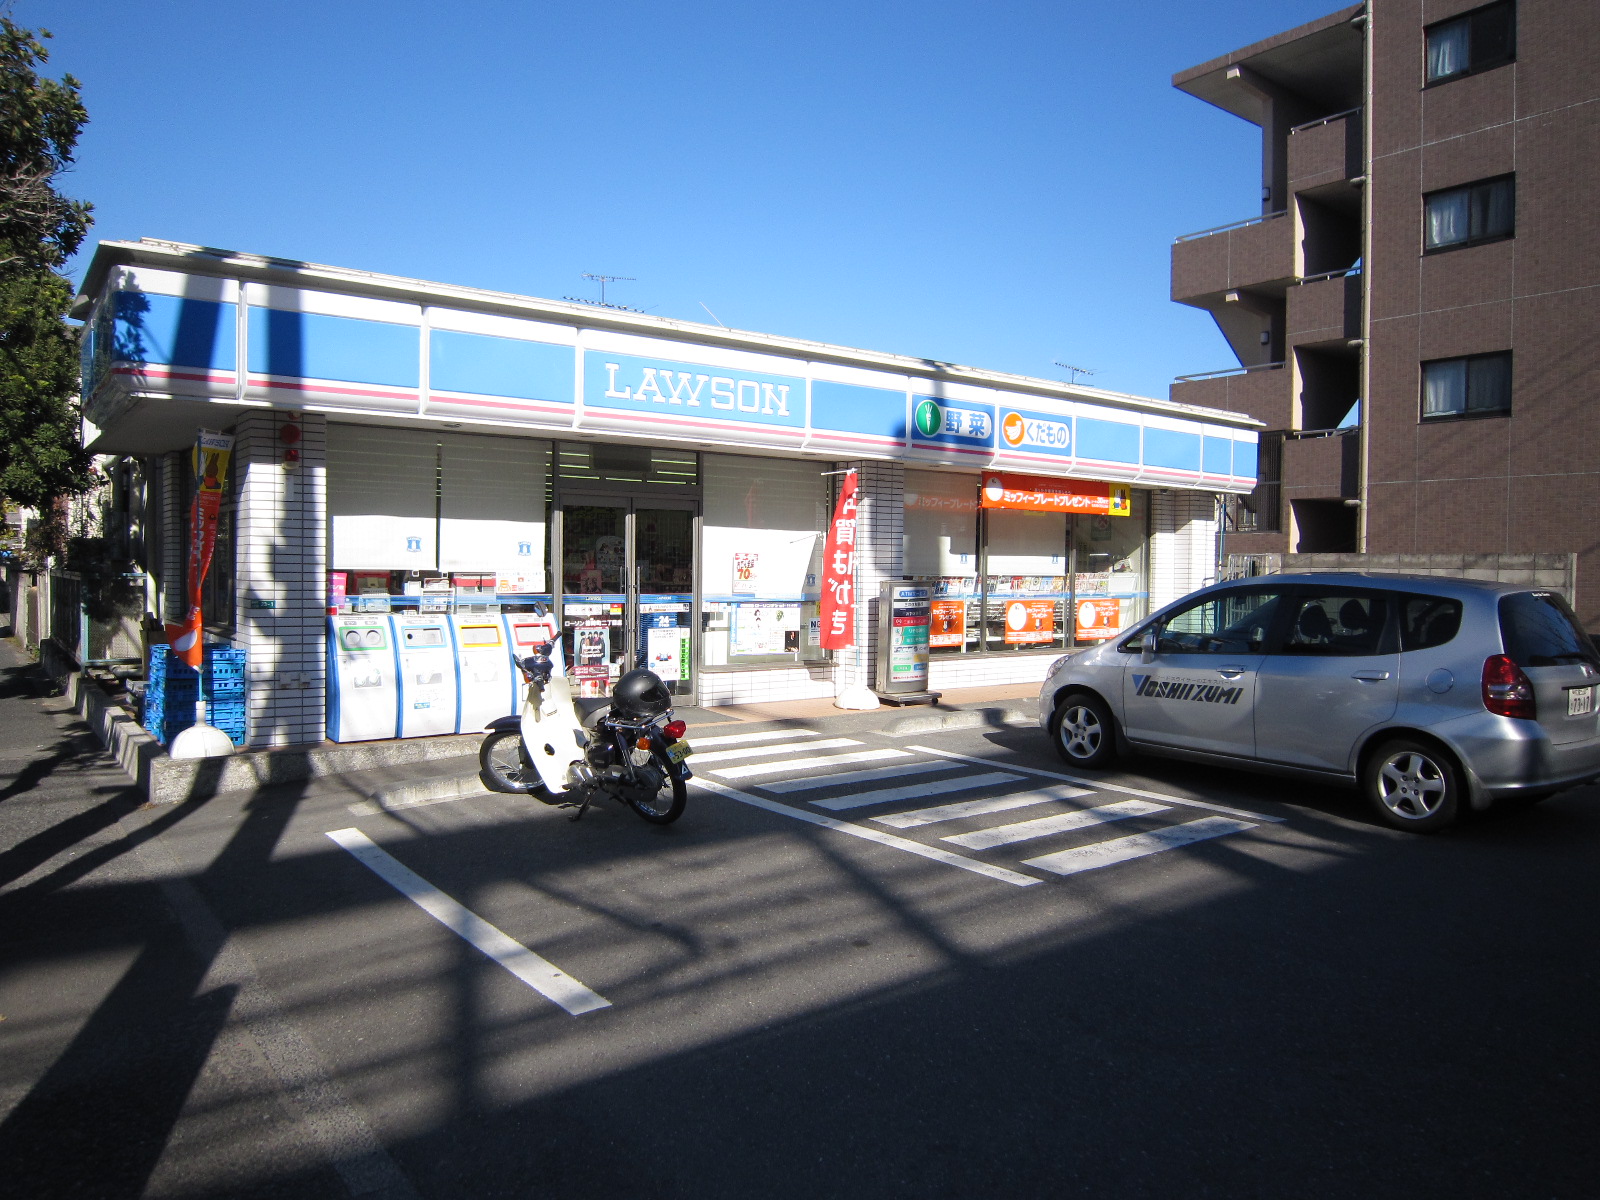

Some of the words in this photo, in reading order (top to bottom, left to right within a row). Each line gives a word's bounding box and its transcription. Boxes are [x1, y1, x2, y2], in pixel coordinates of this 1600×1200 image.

[605, 362, 790, 417] LAWSON
[945, 409, 986, 436] 野菜
[1026, 421, 1067, 446] くだもの
[1003, 490, 1091, 508] ミッフィープレートプレゼント
